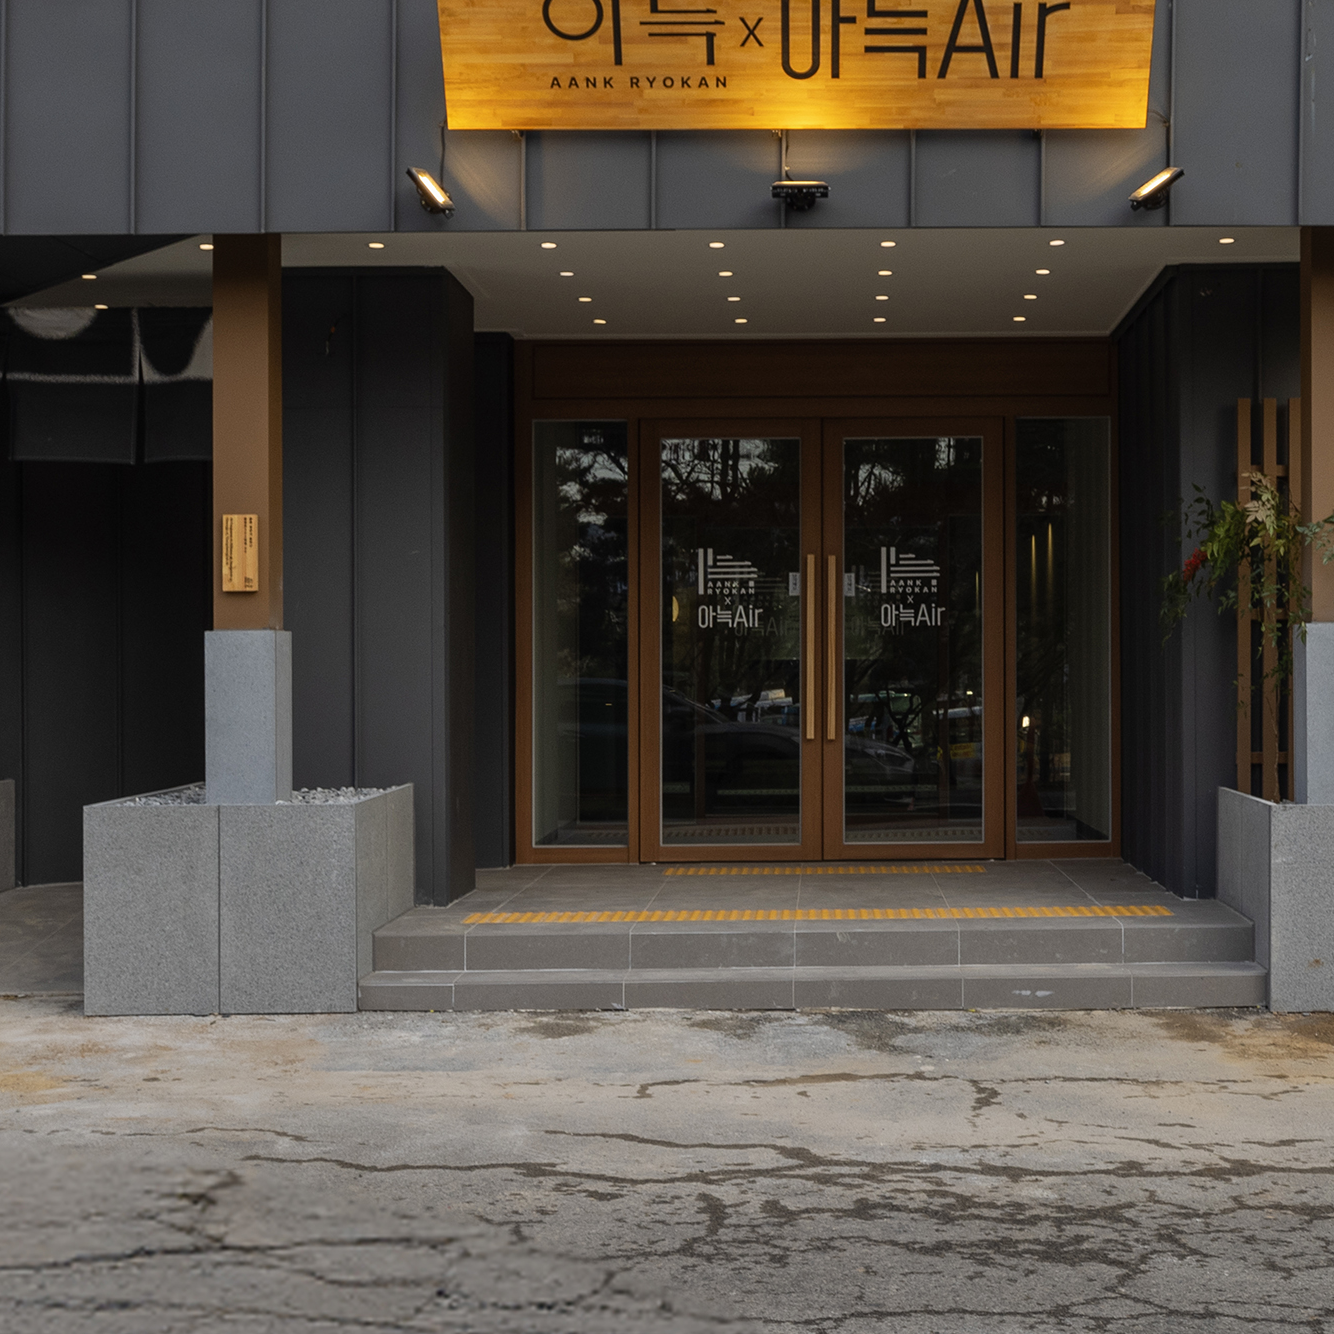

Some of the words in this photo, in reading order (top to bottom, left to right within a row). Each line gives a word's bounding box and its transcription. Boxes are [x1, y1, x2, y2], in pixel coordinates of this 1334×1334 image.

[550, 76, 615, 89] AANK
[630, 76, 728, 89] RYOKAN
[707, 580, 740, 588] AANK
[698, 604, 764, 629] 아늑Air
[880, 603, 947, 627] 아늑Air
